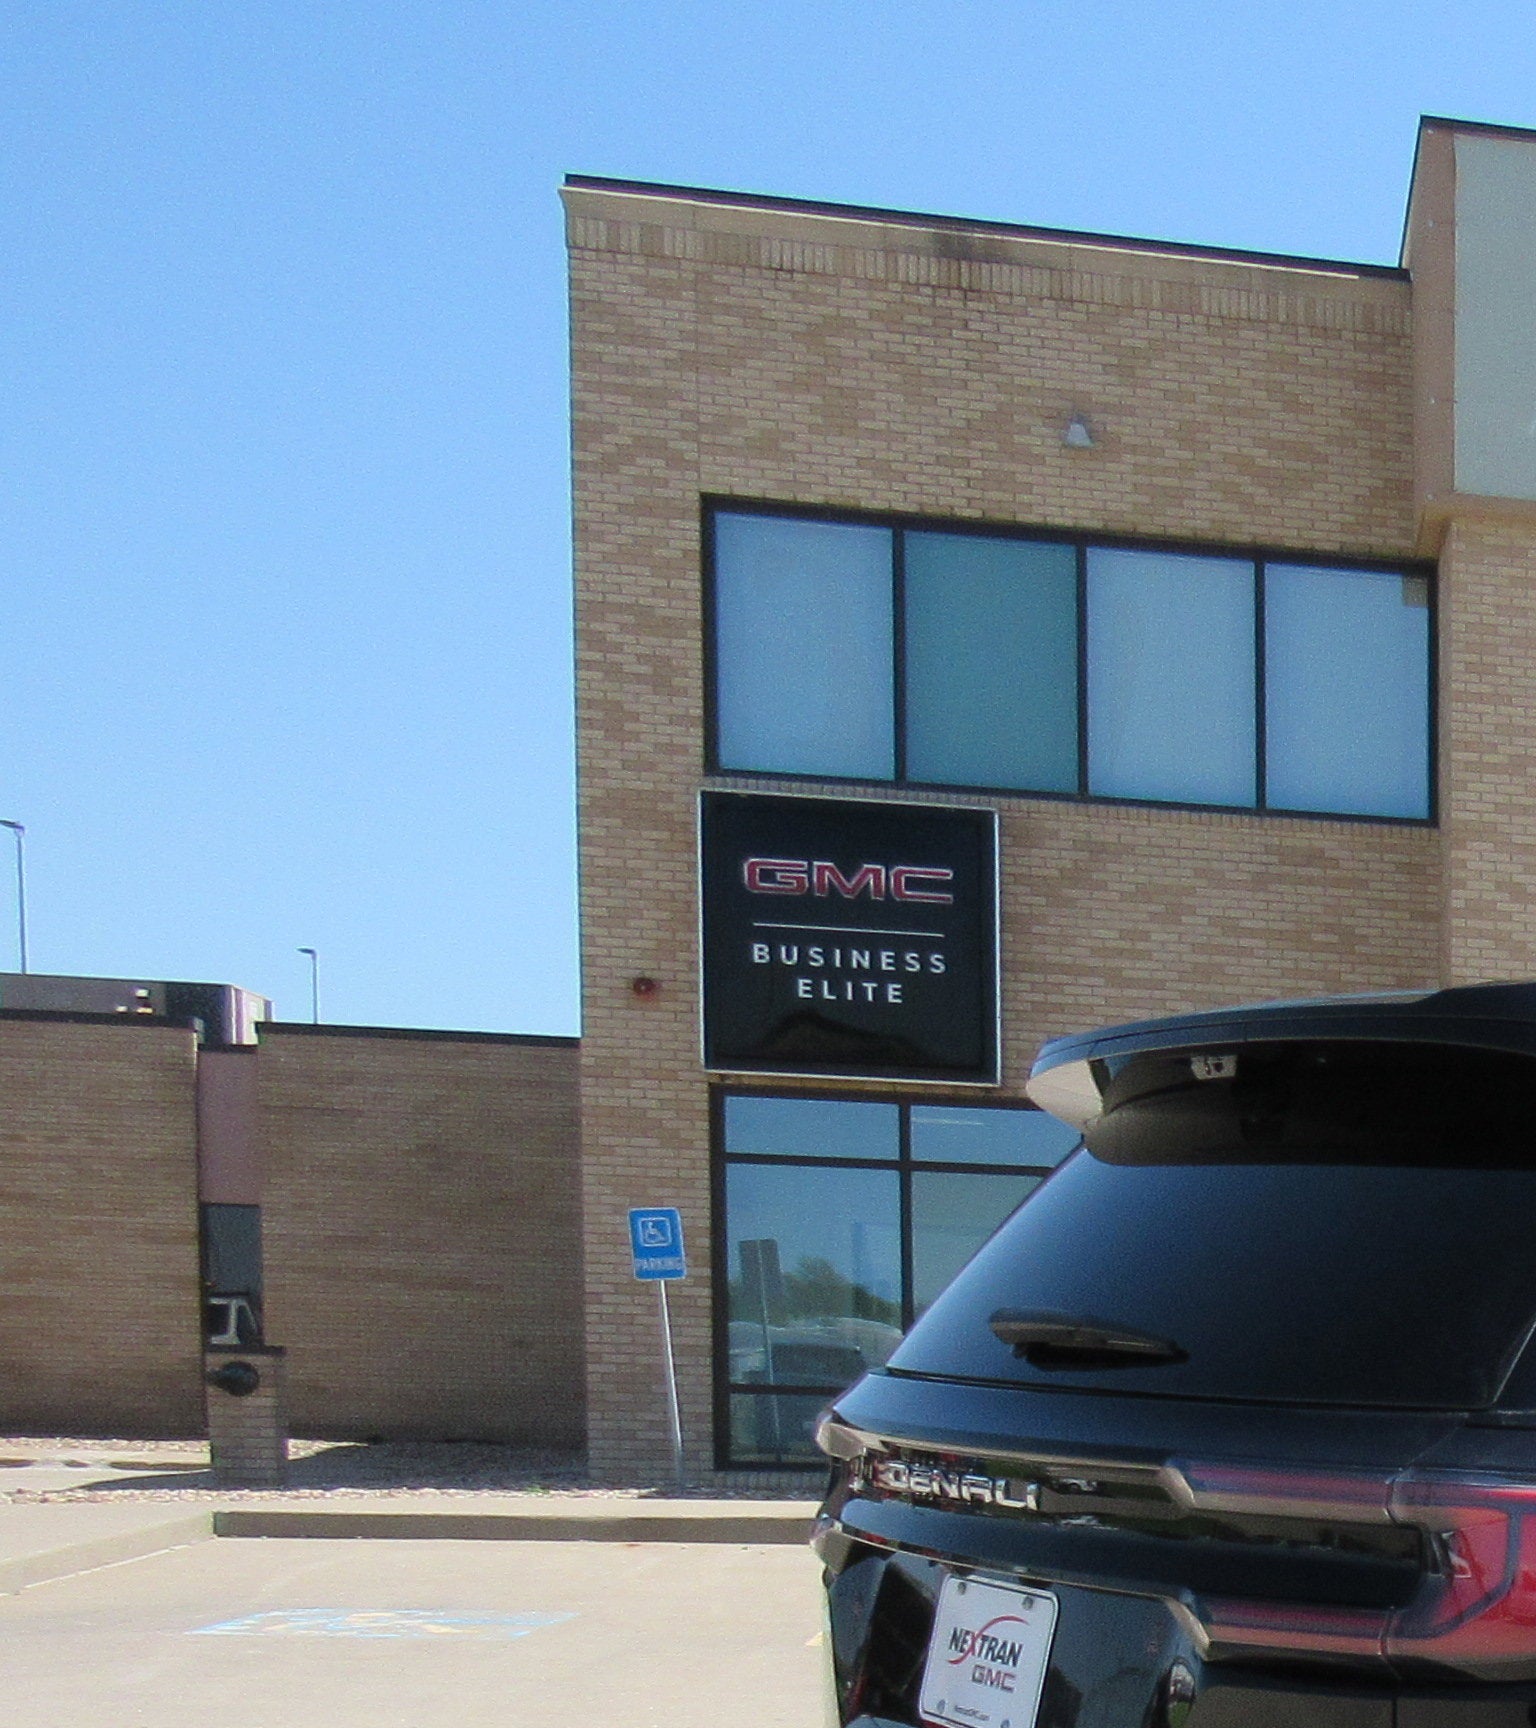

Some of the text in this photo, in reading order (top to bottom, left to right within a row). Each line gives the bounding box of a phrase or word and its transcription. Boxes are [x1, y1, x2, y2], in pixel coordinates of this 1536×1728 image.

[743, 857, 954, 905] GMC
[752, 942, 948, 975] BUSINESS
[797, 977, 904, 1004] ELITE
[875, 1460, 1040, 1511] DENALI
[948, 1625, 1024, 1668] NEXTRAN
[972, 1664, 1016, 1694] GMC
